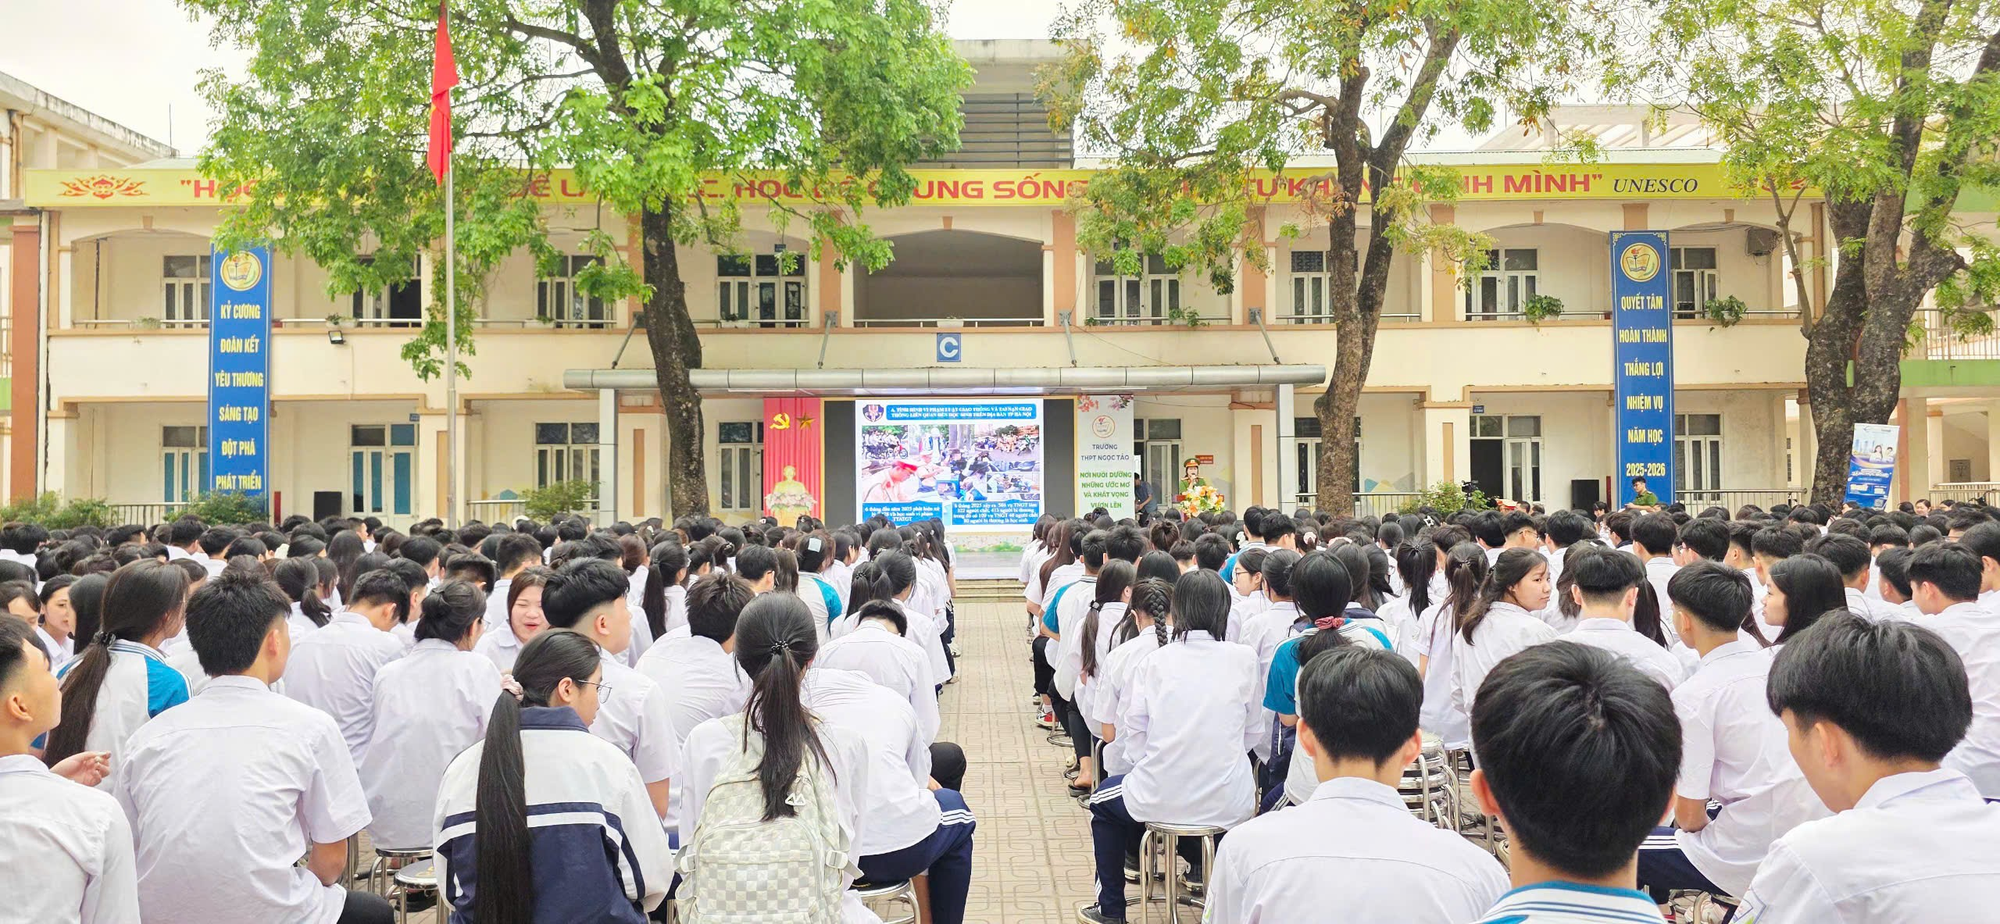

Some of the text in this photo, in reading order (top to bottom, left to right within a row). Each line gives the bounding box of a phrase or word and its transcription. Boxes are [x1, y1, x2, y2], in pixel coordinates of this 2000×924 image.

[1613, 178, 1698, 193] UNESCO
[221, 300, 260, 319] KỶ CƯƠNG
[1621, 292, 1663, 311] QUYẾT TÂM
[221, 334, 259, 353] ĐOÀN KẾT
[1619, 326, 1667, 343] HOÀN THÀNH
[940, 337, 958, 358] C
[1624, 357, 1663, 379] THẮNG LỢI
[215, 370, 264, 387] YÊU THƯƠNG
[1627, 393, 1663, 413] NHIỆM VỤ
[219, 404, 258, 424] SÁNG TẠO
[1627, 427, 1663, 446] NĂM HỌC
[222, 438, 255, 459] ĐỘT PHÁ
[216, 469, 261, 489] PHÁT TRIỂN
[1626, 463, 1666, 476] 2025-2026
